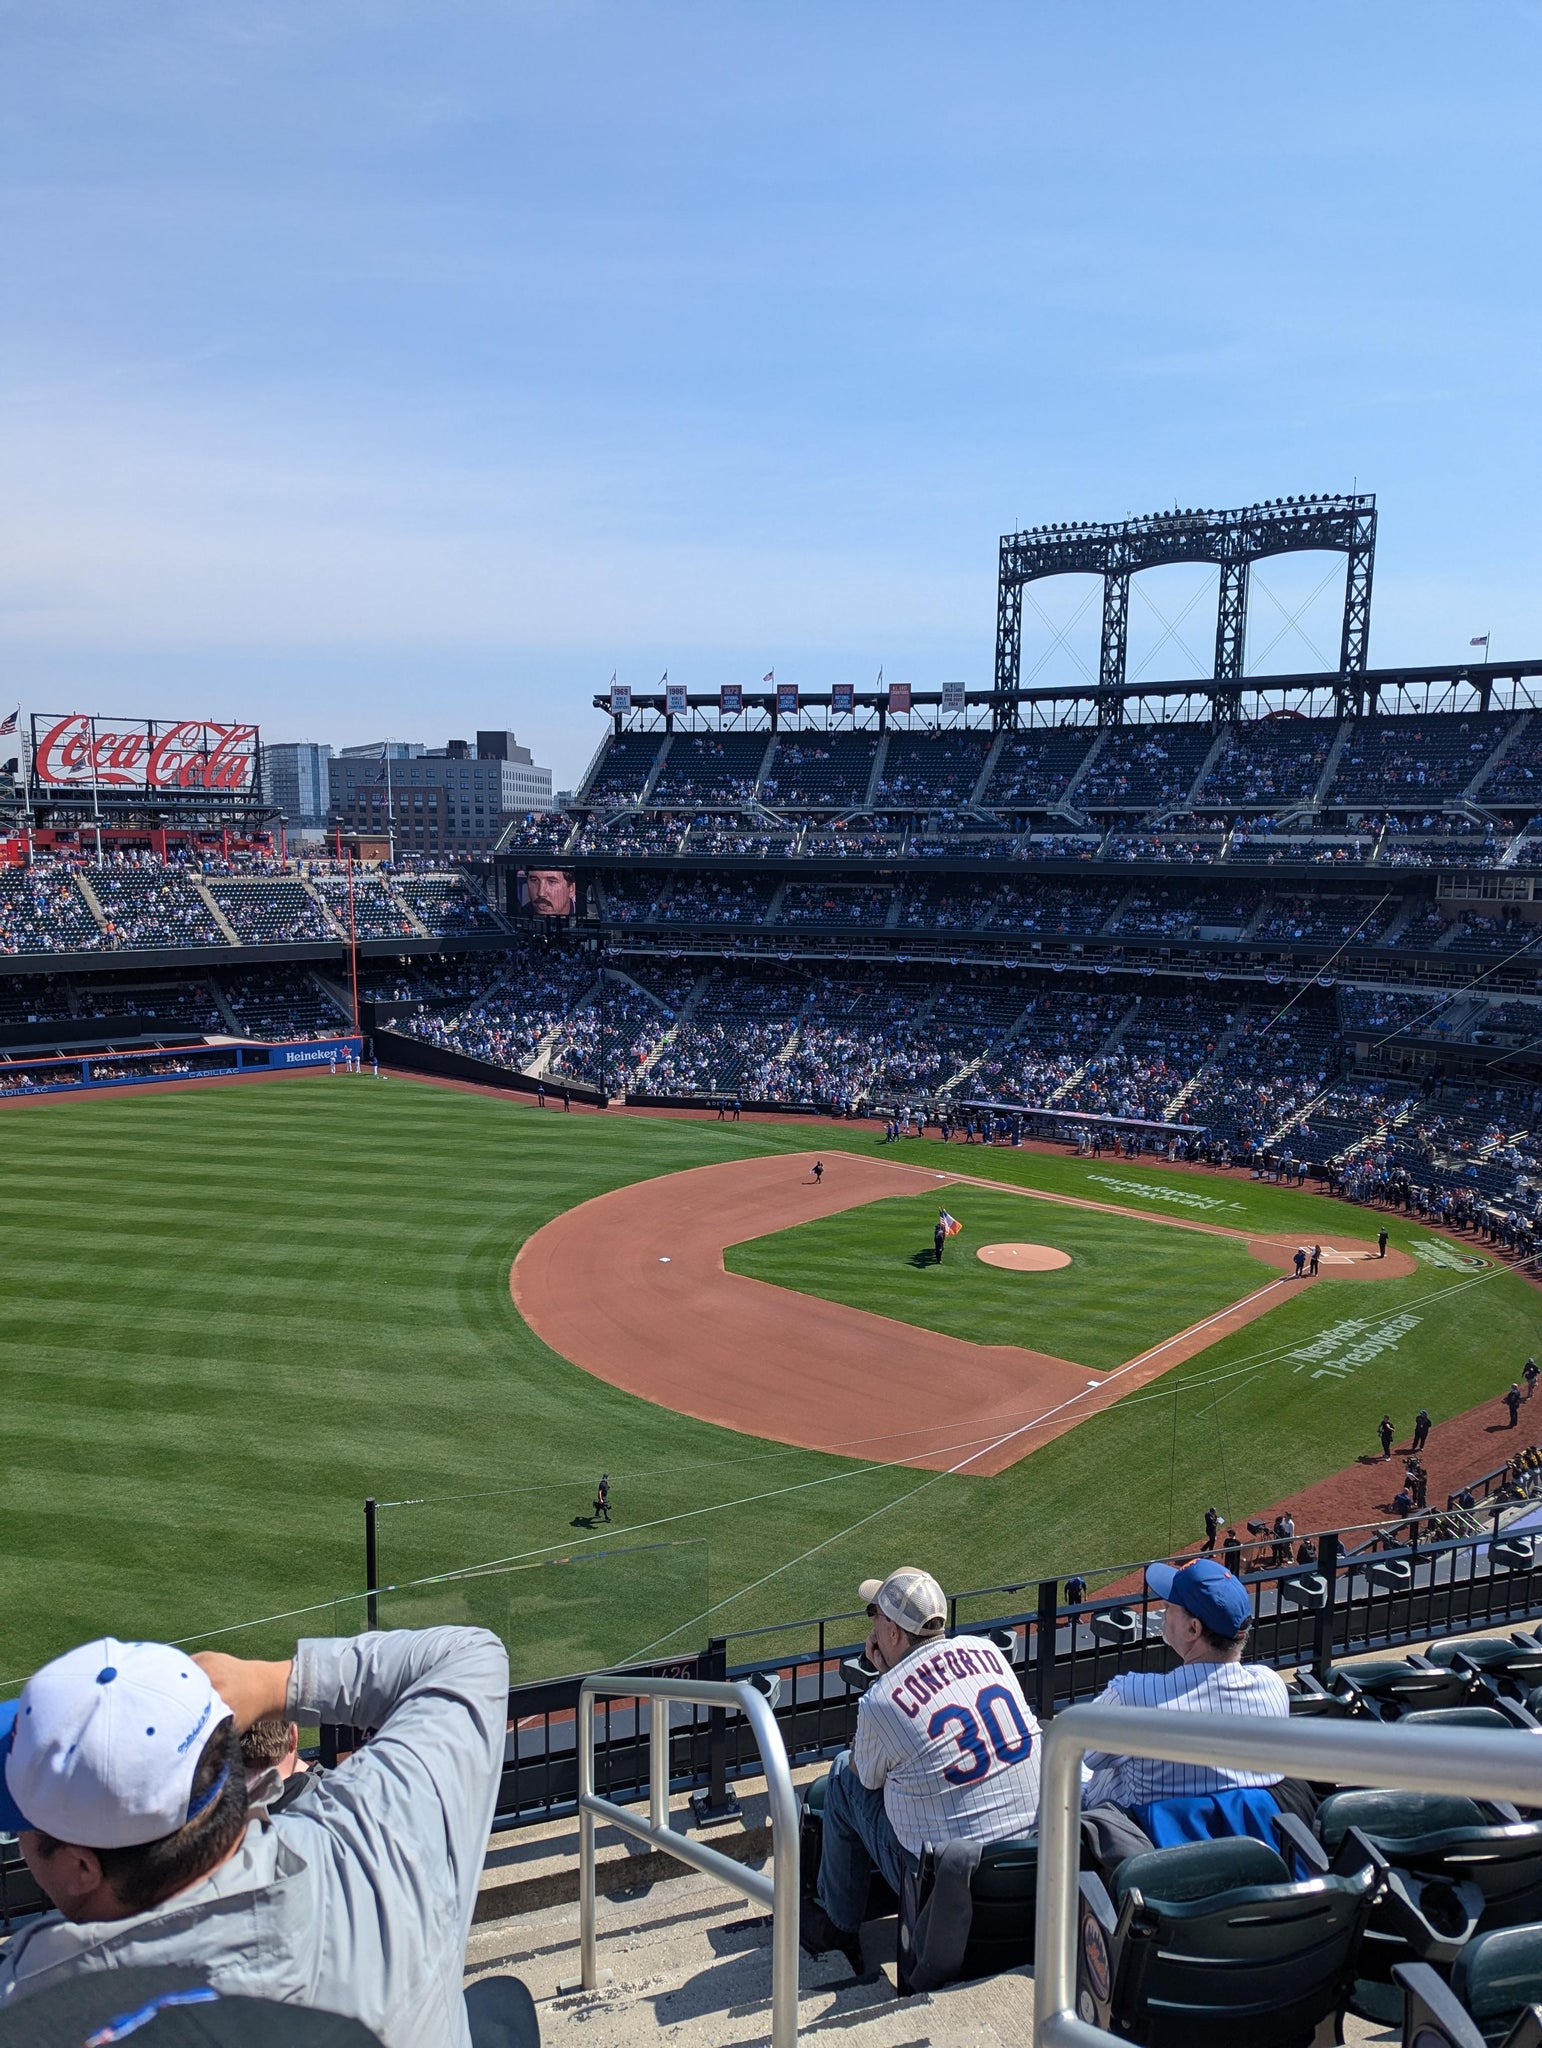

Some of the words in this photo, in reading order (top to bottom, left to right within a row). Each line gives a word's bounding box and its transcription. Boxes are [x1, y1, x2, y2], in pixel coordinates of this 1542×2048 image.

[36, 715, 259, 787] Coca-Cola
[188, 1067, 240, 1078] CADILLAC
[286, 1050, 337, 1062] Heineken
[1086, 1174, 1226, 1206] Presbyterian
[1323, 1314, 1424, 1373] Presbyterian
[891, 1648, 1004, 1719] CONFORTO
[927, 1683, 1033, 1786] 30
